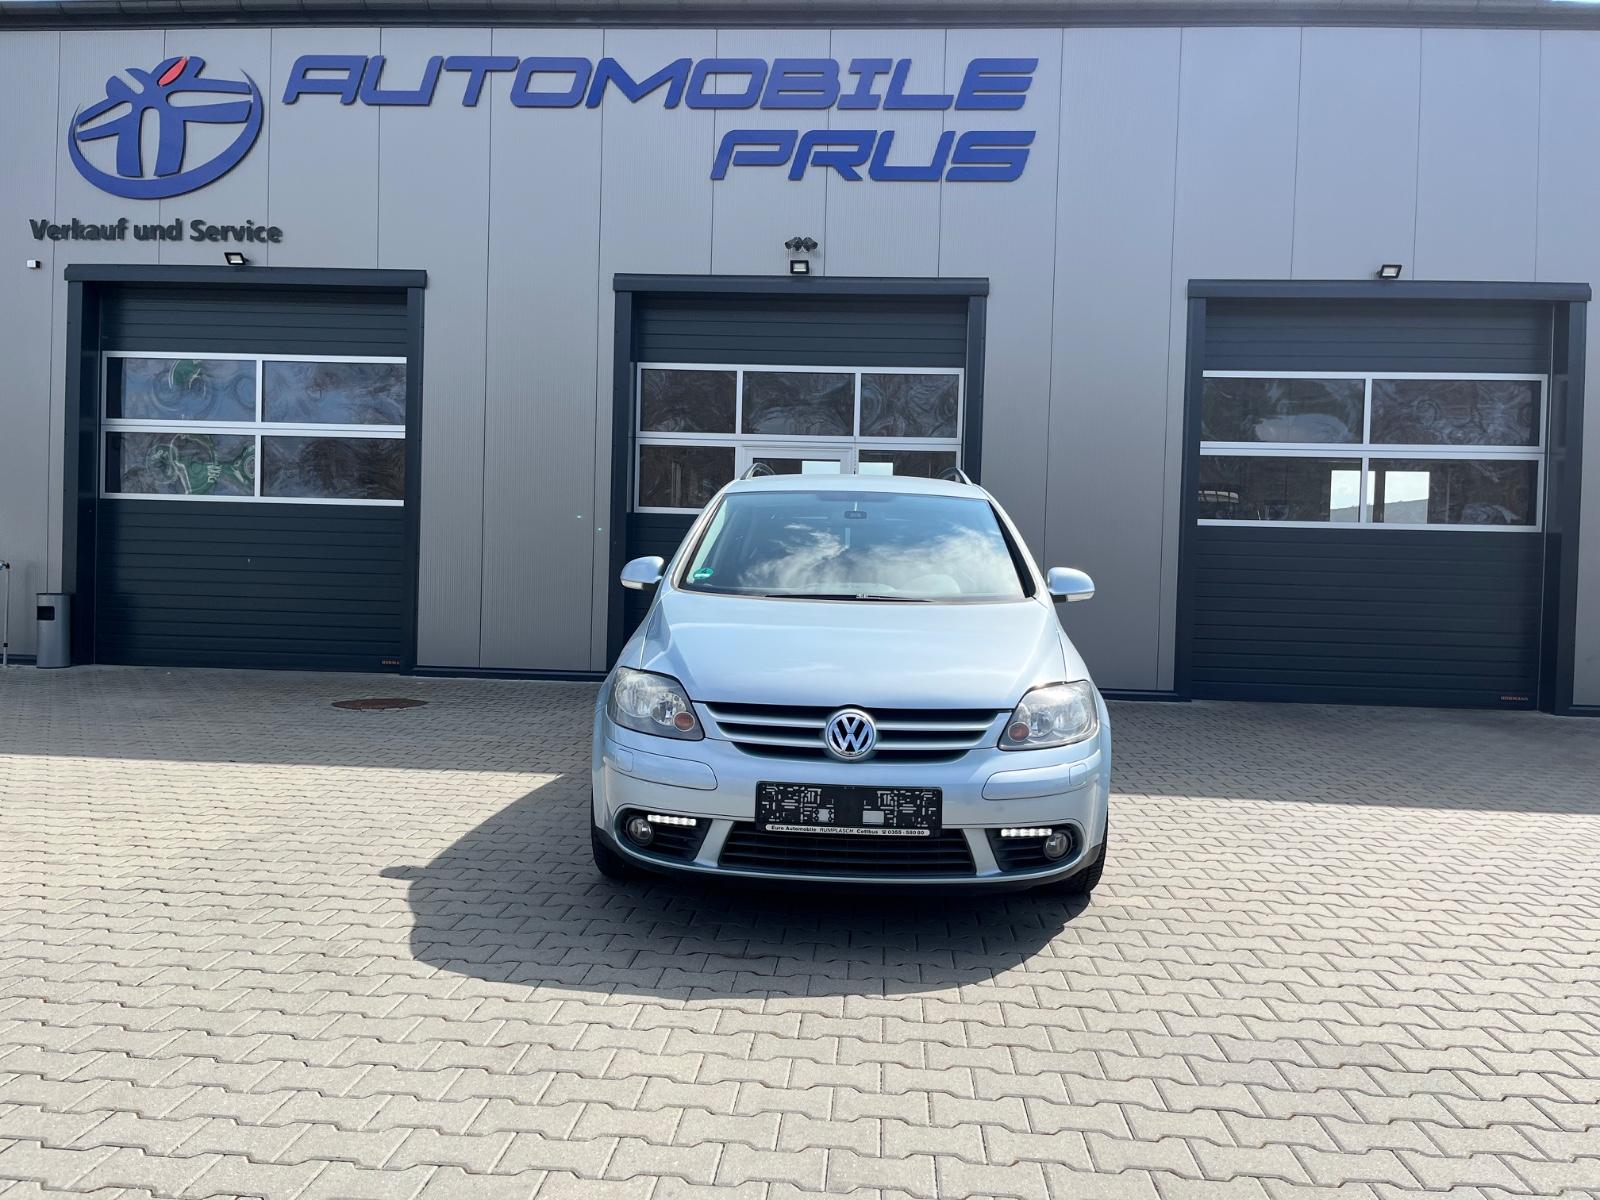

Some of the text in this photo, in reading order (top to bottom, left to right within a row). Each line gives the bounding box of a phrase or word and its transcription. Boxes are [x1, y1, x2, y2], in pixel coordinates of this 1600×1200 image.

[282, 55, 1039, 110] AUTOMOBILE
[711, 129, 1036, 182] PRUS
[29, 217, 283, 243] Verkauf und Service
